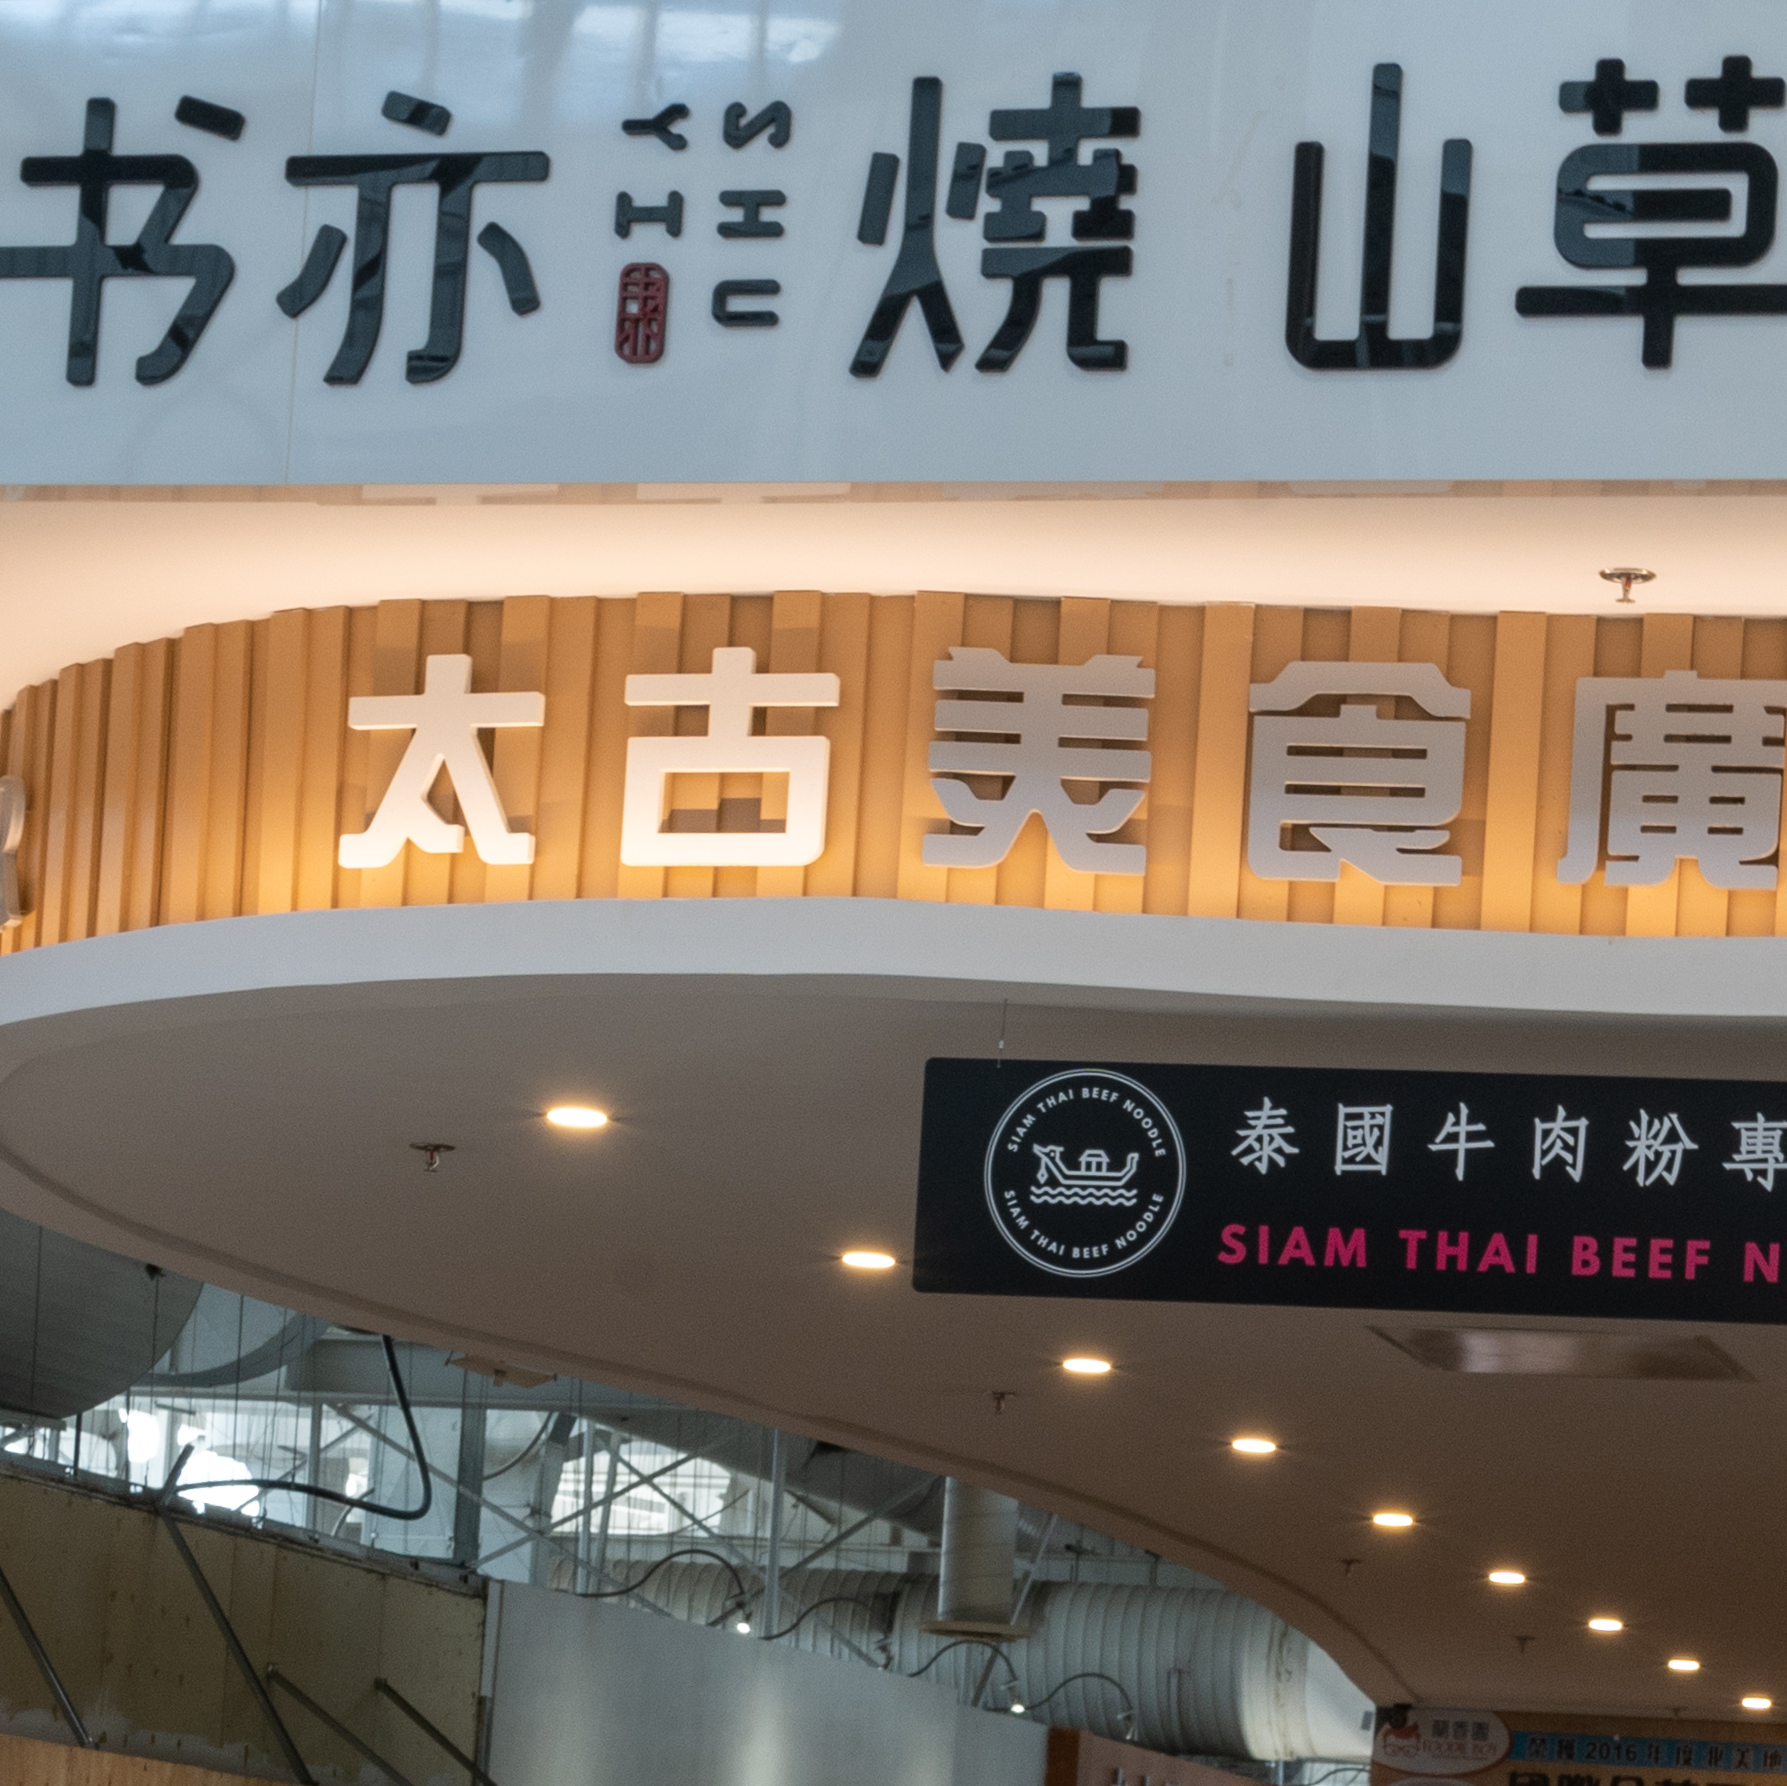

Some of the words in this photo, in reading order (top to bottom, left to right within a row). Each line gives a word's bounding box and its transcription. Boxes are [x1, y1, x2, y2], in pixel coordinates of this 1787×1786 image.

[614, 102, 690, 240] YI
[712, 100, 792, 328] SHU
[1007, 1113, 1037, 1152] SIAM
[1036, 1088, 1075, 1114] THAI
[1081, 1087, 1120, 1103] BEEF
[1122, 1099, 1167, 1158] NOODLE
[1003, 1189, 1030, 1230] SIAM
[1029, 1229, 1066, 1256] THAI
[1071, 1244, 1110, 1259] BEEF
[1114, 1192, 1165, 1250] NOODLE
[1216, 1222, 1372, 1270] SIAM
[1398, 1228, 1540, 1276] THAI
[1570, 1235, 1713, 1282] BEEF
